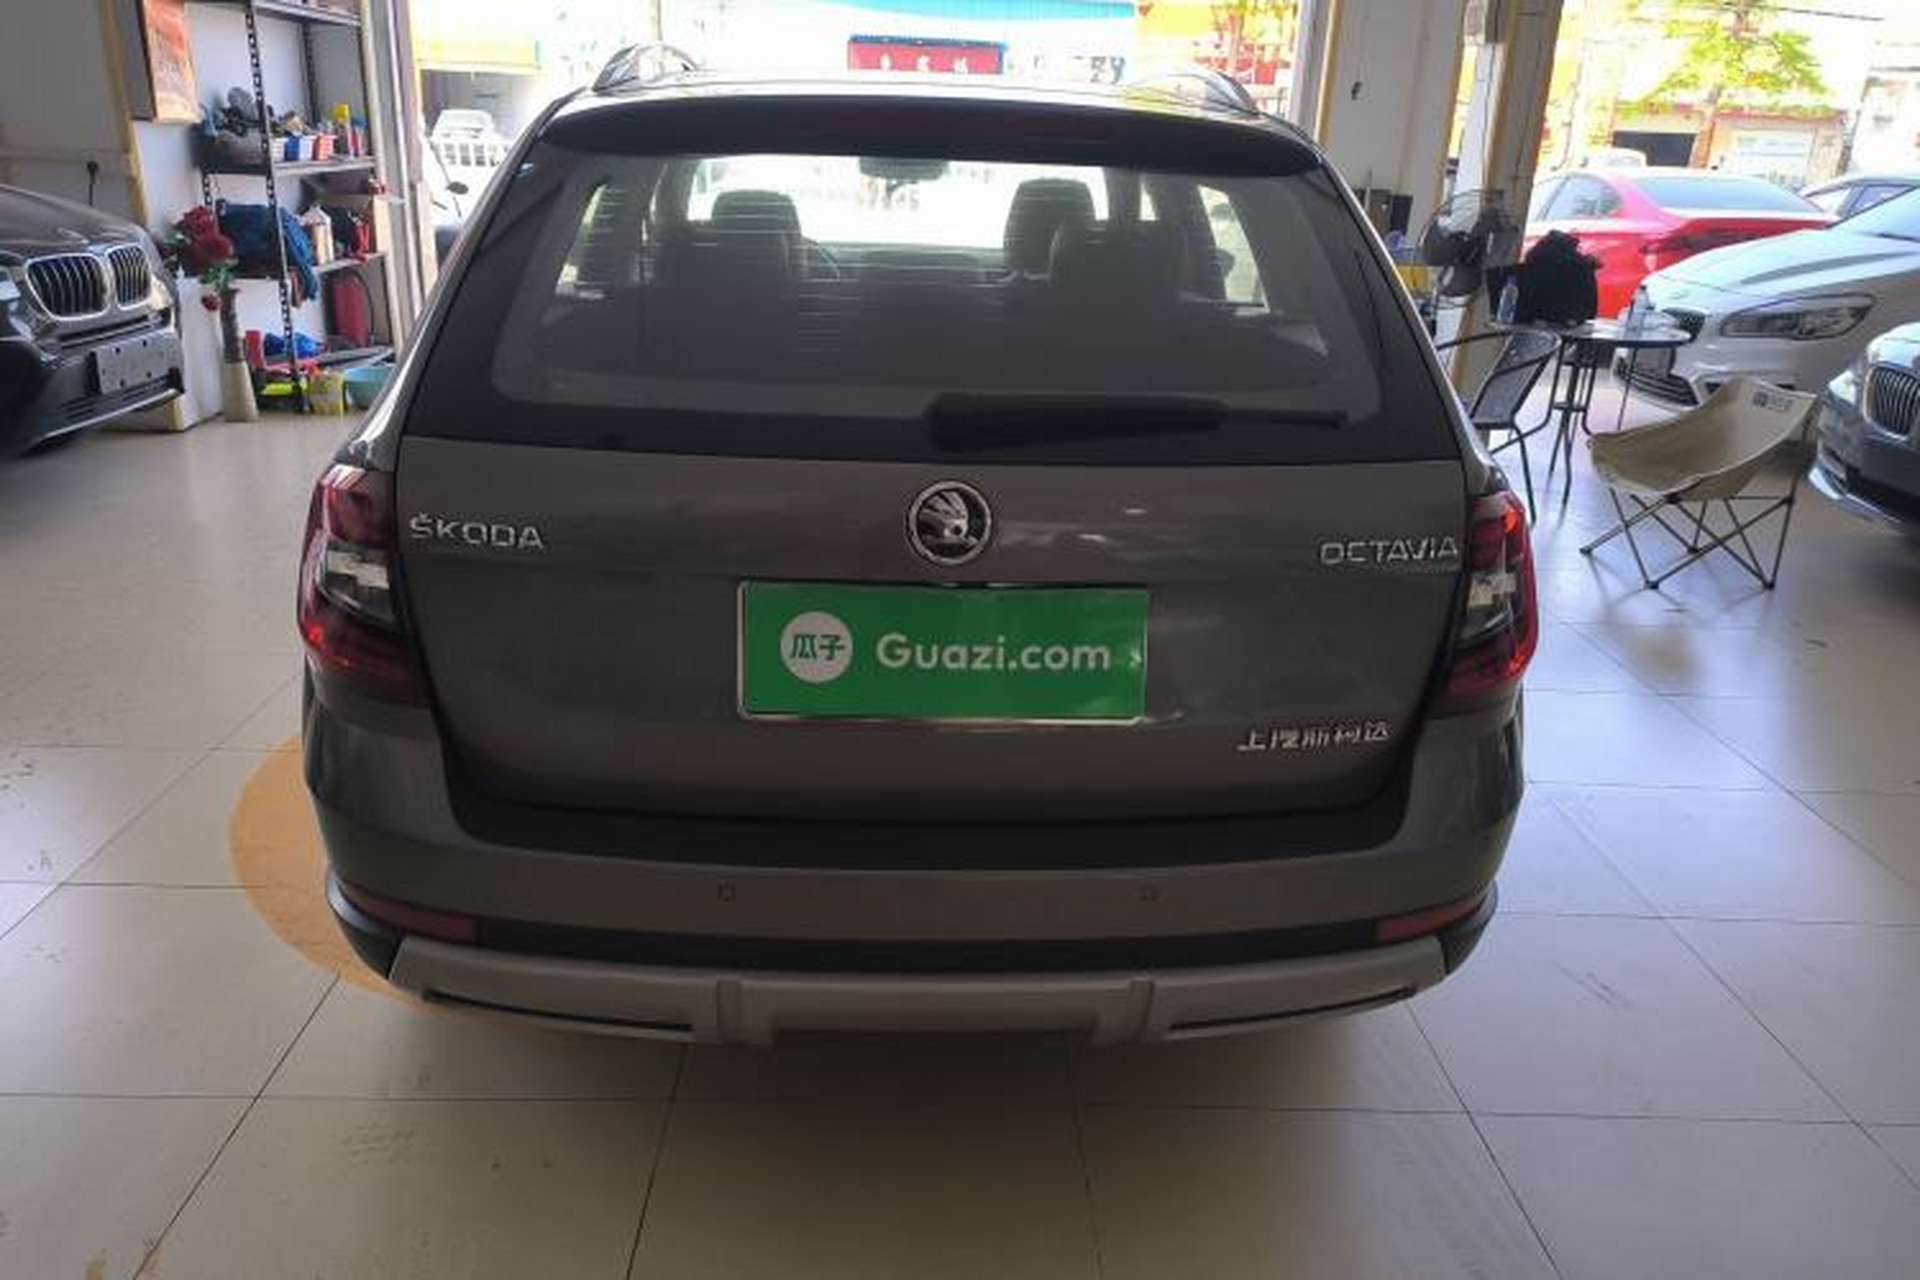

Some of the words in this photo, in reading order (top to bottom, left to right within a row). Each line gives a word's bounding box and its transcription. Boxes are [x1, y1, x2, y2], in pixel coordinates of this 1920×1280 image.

[410, 511, 544, 549] ŠKODA
[1320, 536, 1458, 565] OCTAVIA
[789, 634, 846, 661] 瓜子
[876, 633, 1112, 672] Guazi.com
